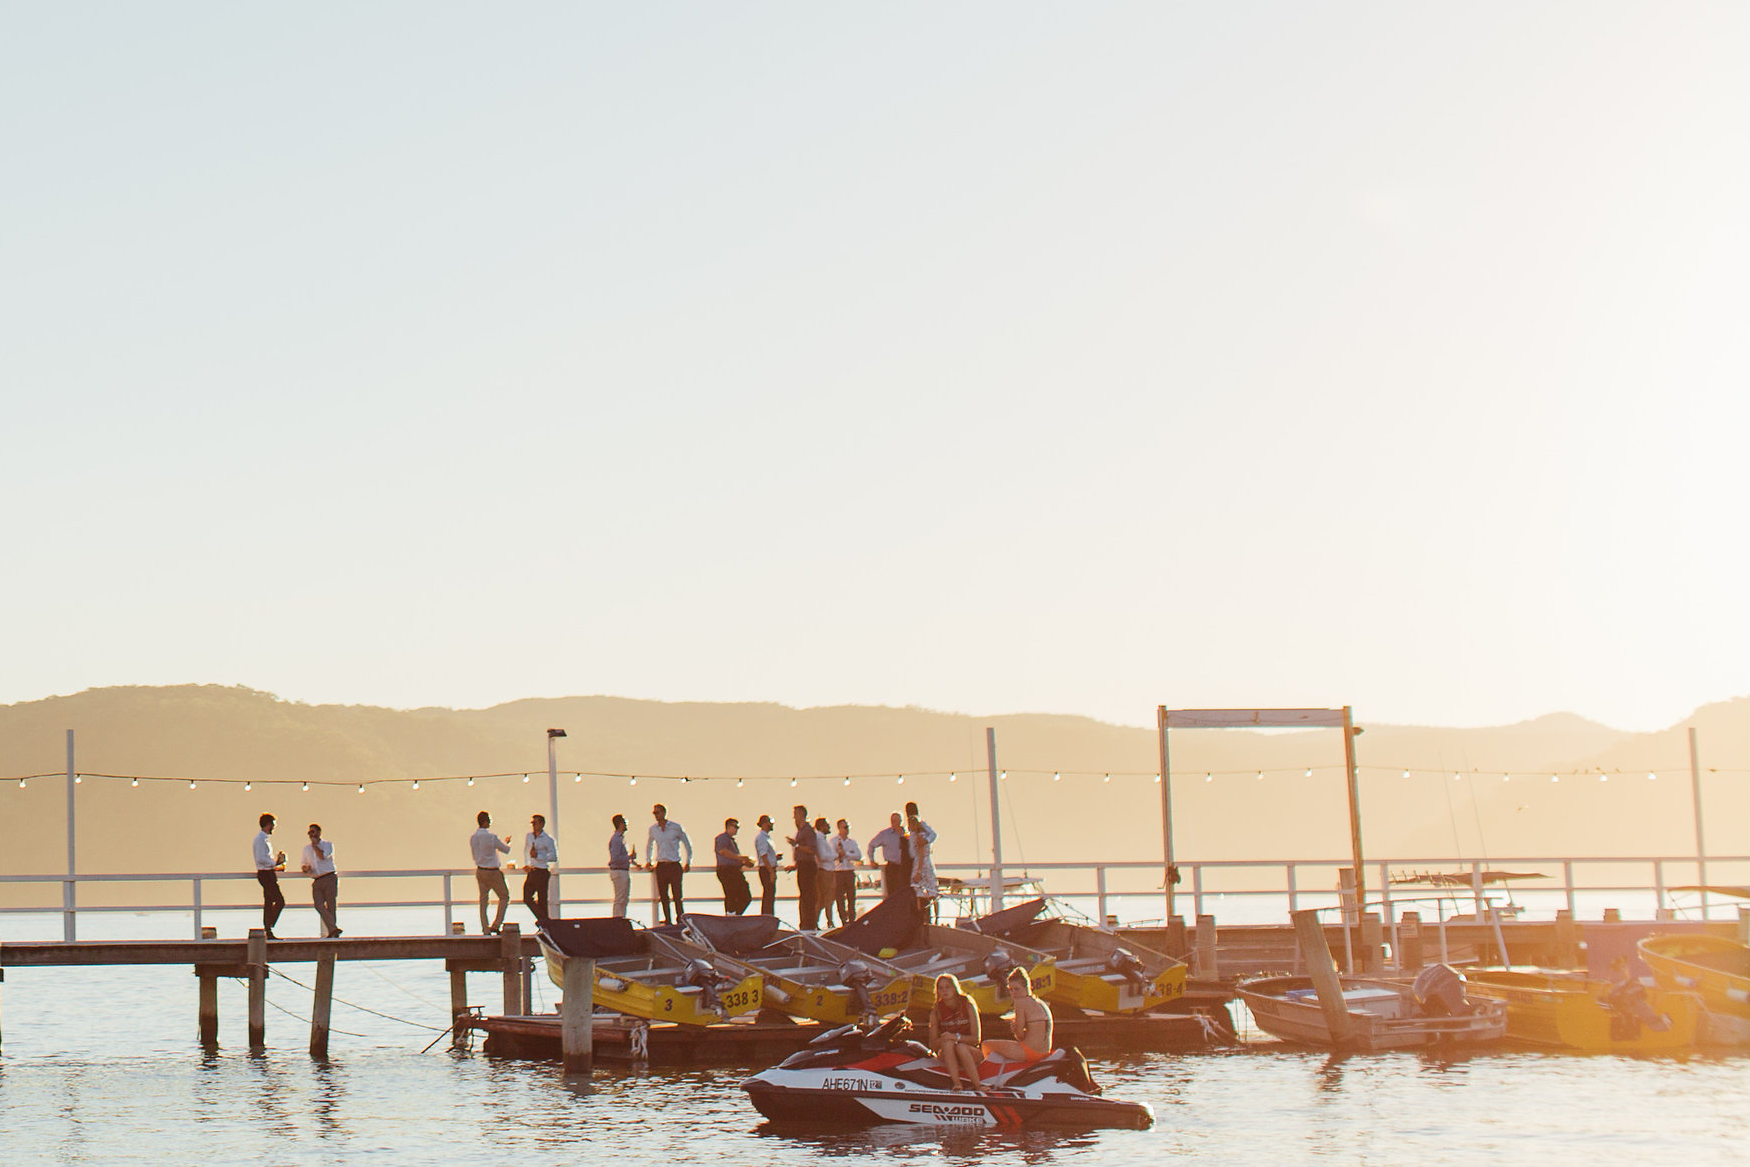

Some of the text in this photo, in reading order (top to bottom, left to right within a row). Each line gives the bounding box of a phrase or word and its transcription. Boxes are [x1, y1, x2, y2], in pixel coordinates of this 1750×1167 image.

[664, 998, 673, 1012] 3
[725, 991, 749, 1008] 338
[816, 994, 824, 1006] 2
[875, 990, 908, 1007] 338:2
[822, 1077, 868, 1091] AHE671N
